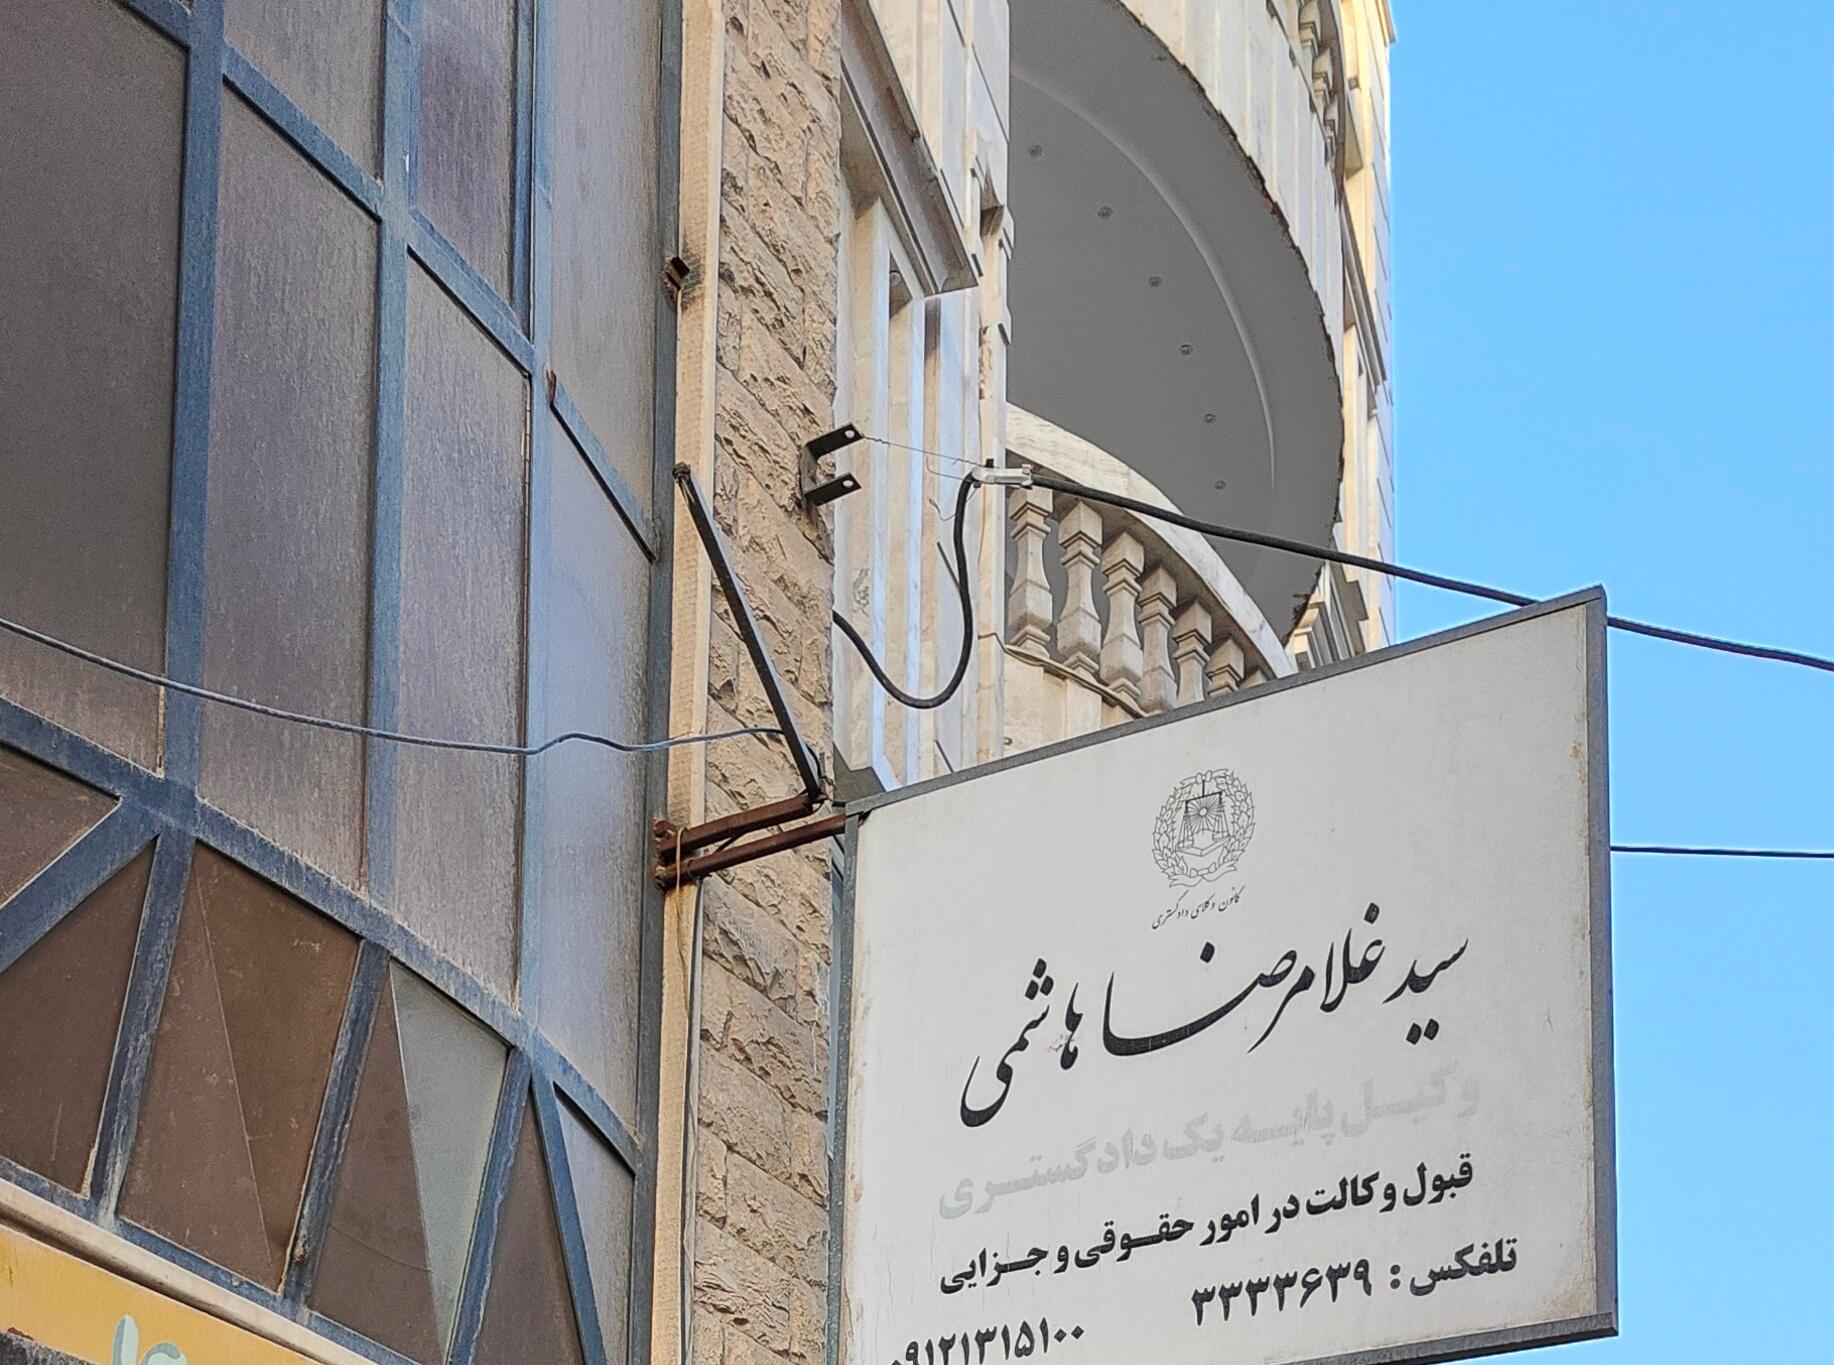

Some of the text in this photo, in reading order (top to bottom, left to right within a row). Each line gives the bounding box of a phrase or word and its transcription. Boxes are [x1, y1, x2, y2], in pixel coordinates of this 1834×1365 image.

[959, 901, 1469, 1128] سید غلامرضا هاشمی
[1162, 1111, 1226, 1163] یک
[1231, 1088, 1334, 1148] پایه
[1340, 1061, 1480, 1138] وکیل
[939, 1152, 1474, 1296] قبول وکالت در امور حقوقی و جزایی
